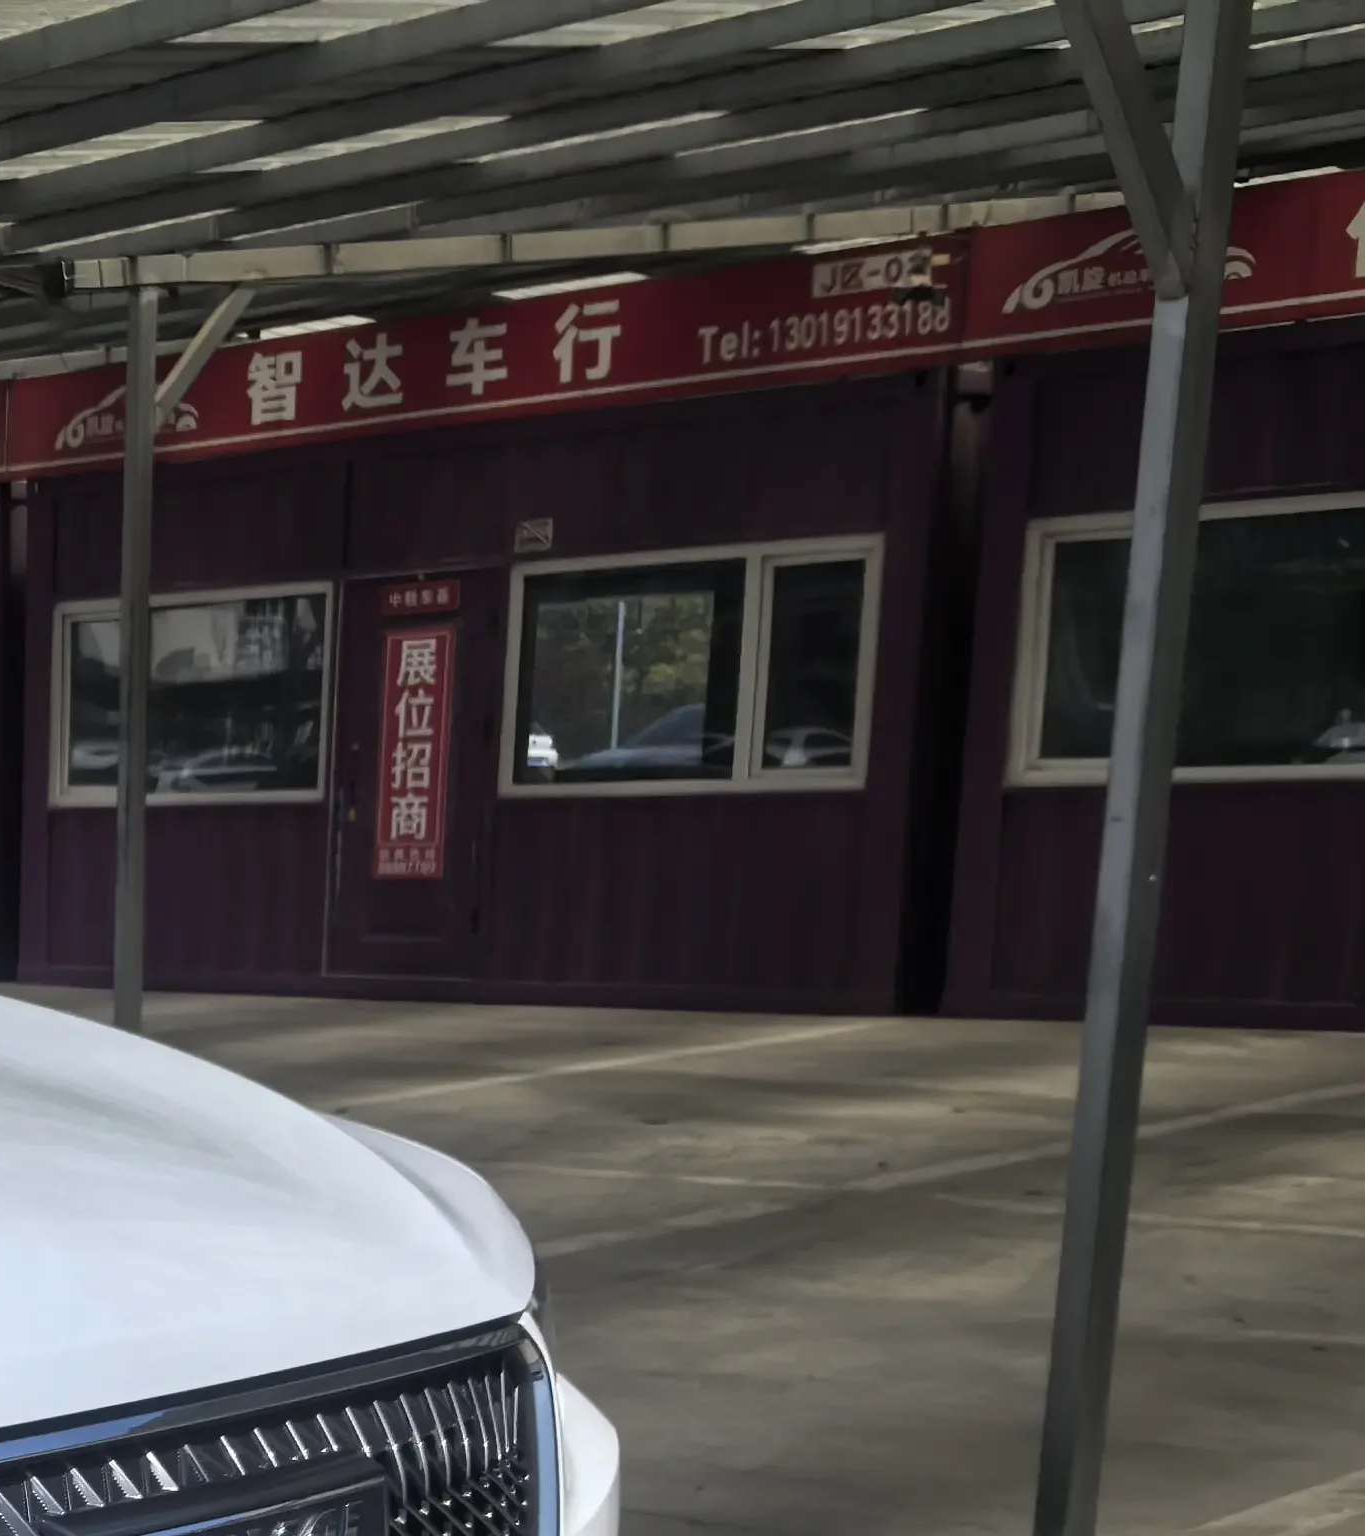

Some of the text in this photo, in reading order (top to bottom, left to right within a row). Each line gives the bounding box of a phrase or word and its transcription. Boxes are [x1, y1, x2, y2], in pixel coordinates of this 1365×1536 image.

[247, 299, 622, 426] 智达车行
[389, 638, 437, 841] 展位招商
